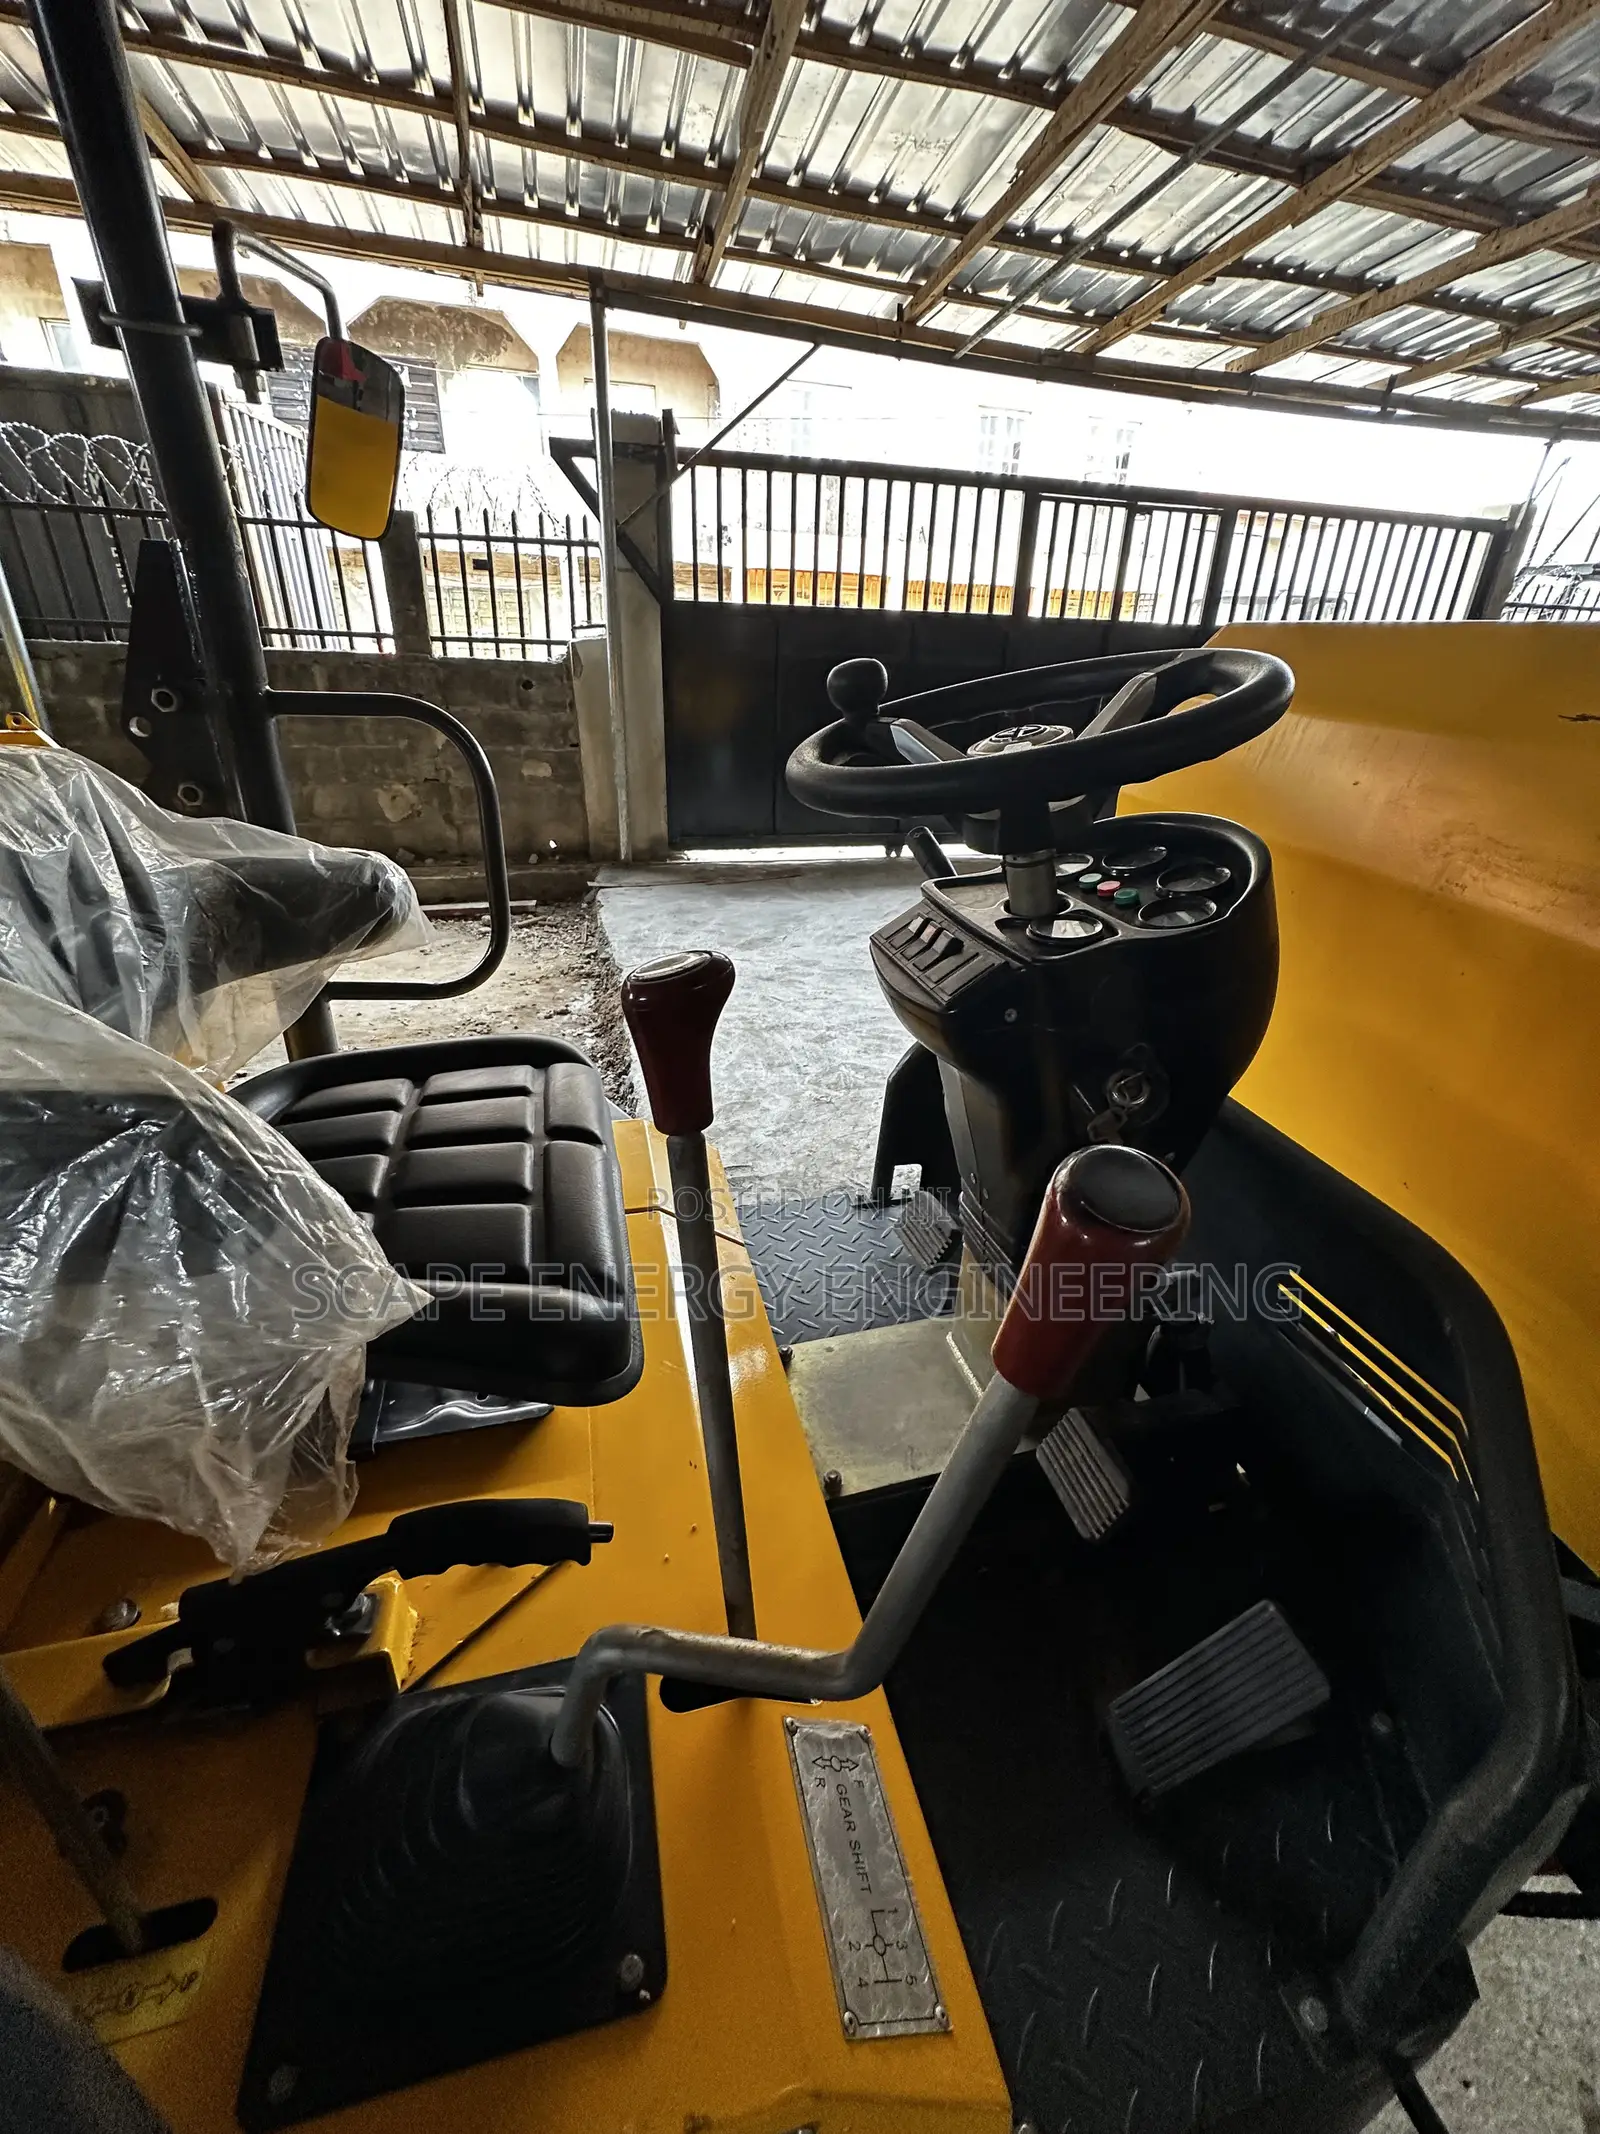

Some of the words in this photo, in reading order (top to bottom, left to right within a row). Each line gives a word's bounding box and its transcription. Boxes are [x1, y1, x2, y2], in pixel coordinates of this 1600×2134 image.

[814, 1776, 826, 1789] R
[854, 1779, 865, 1789] F
[836, 1783, 856, 1832] GEAR
[849, 1840, 872, 1895] SHIFT
[848, 1940, 861, 1951] 2
[896, 1940, 908, 1951] 3
[857, 1976, 869, 1989] 4
[905, 1973, 917, 1986] 5
